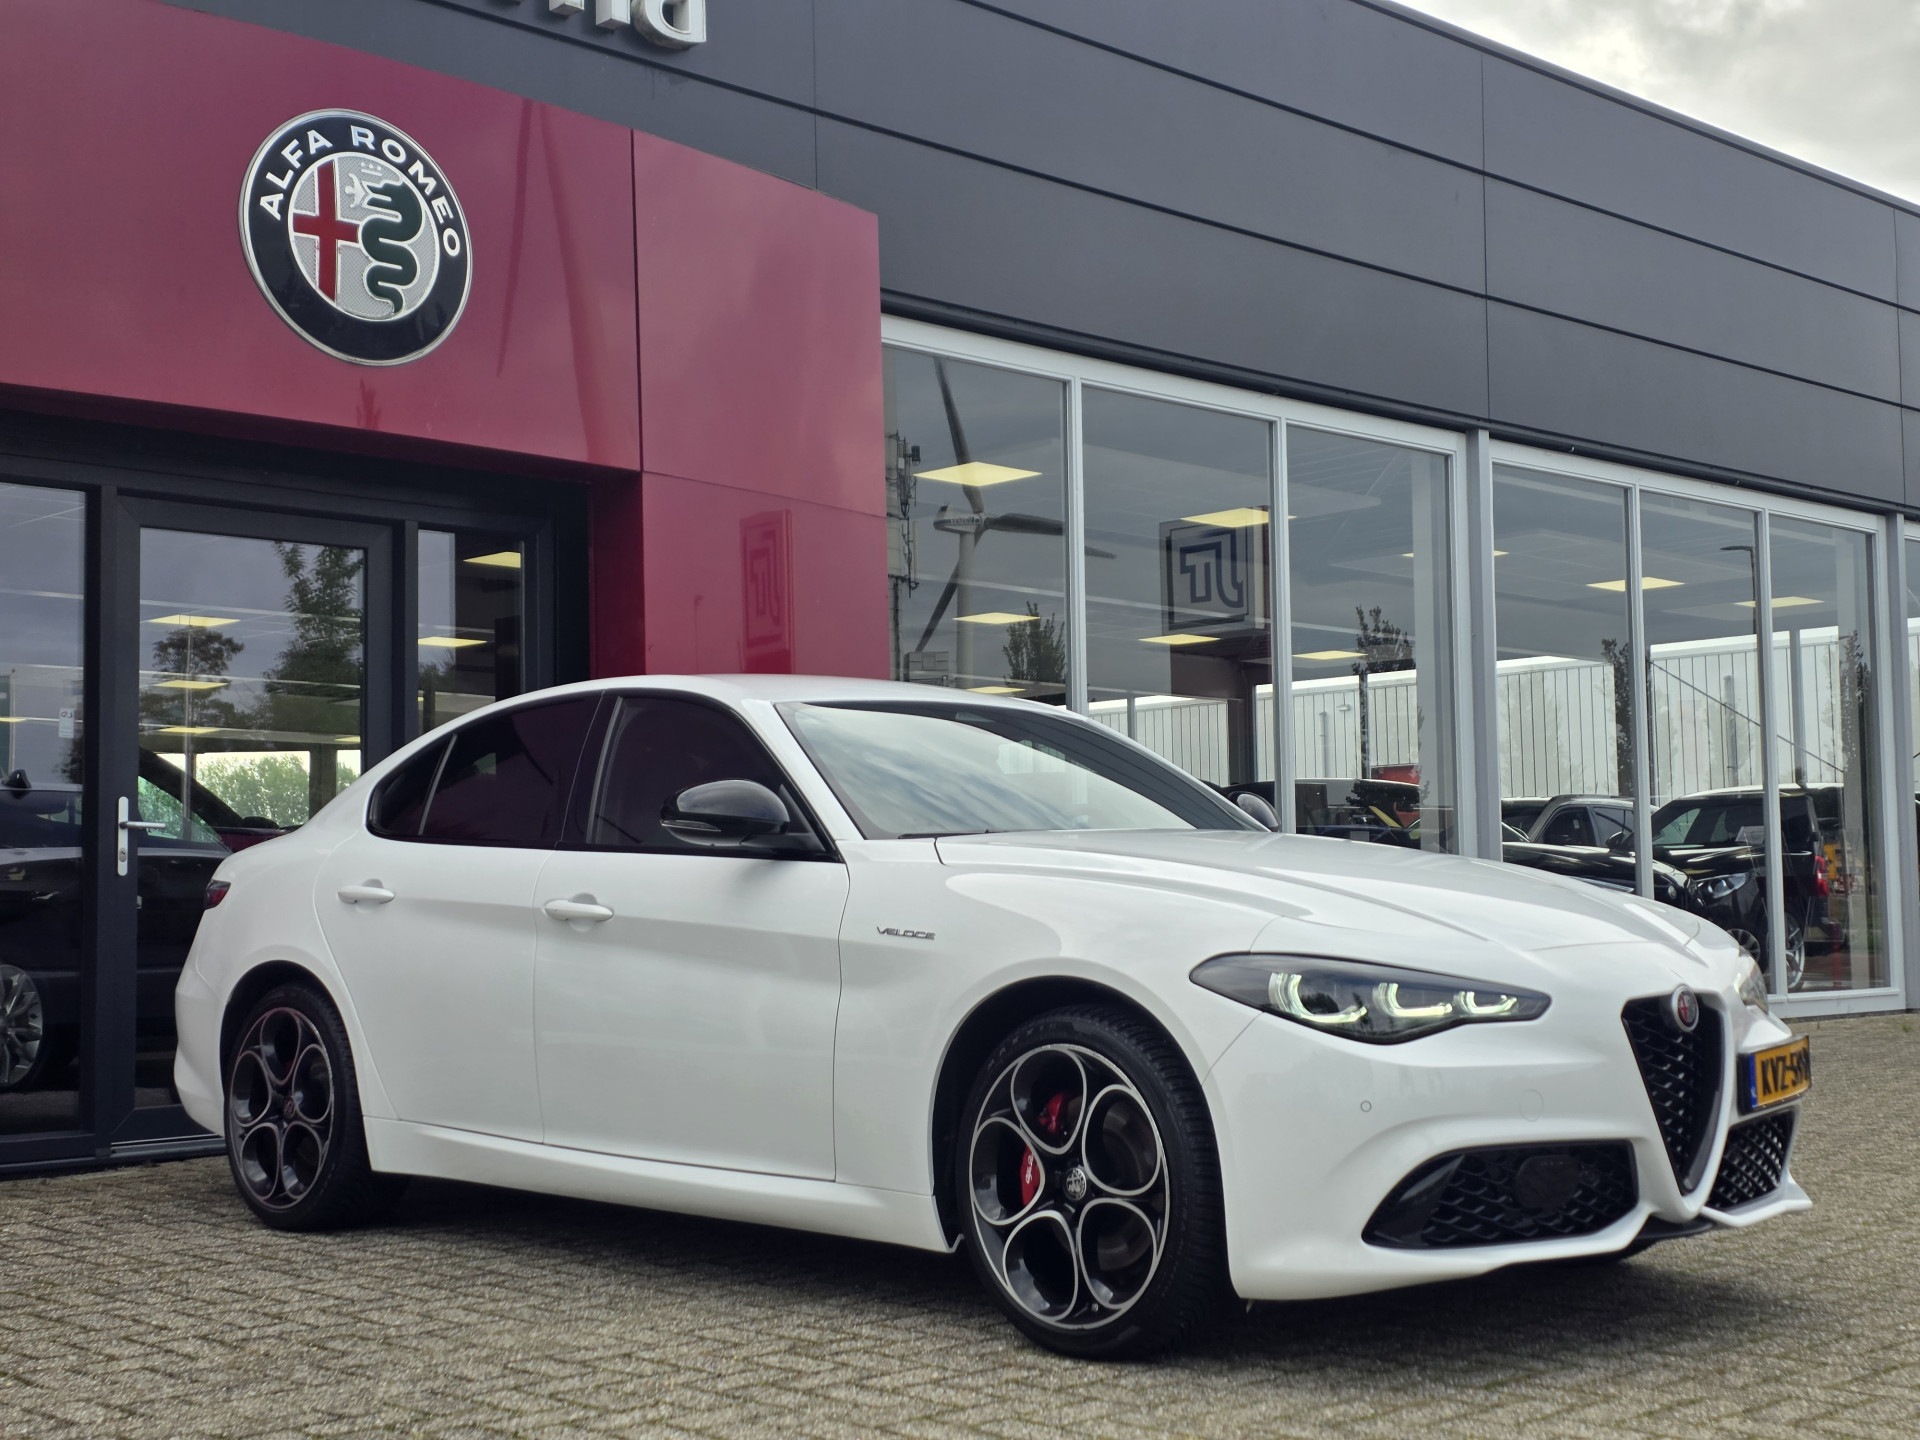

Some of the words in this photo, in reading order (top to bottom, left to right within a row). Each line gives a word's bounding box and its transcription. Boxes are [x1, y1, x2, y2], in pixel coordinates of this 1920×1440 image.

[259, 129, 334, 221] ALFA
[350, 125, 461, 257] ROMEO
[876, 927, 936, 941] VELOCE
